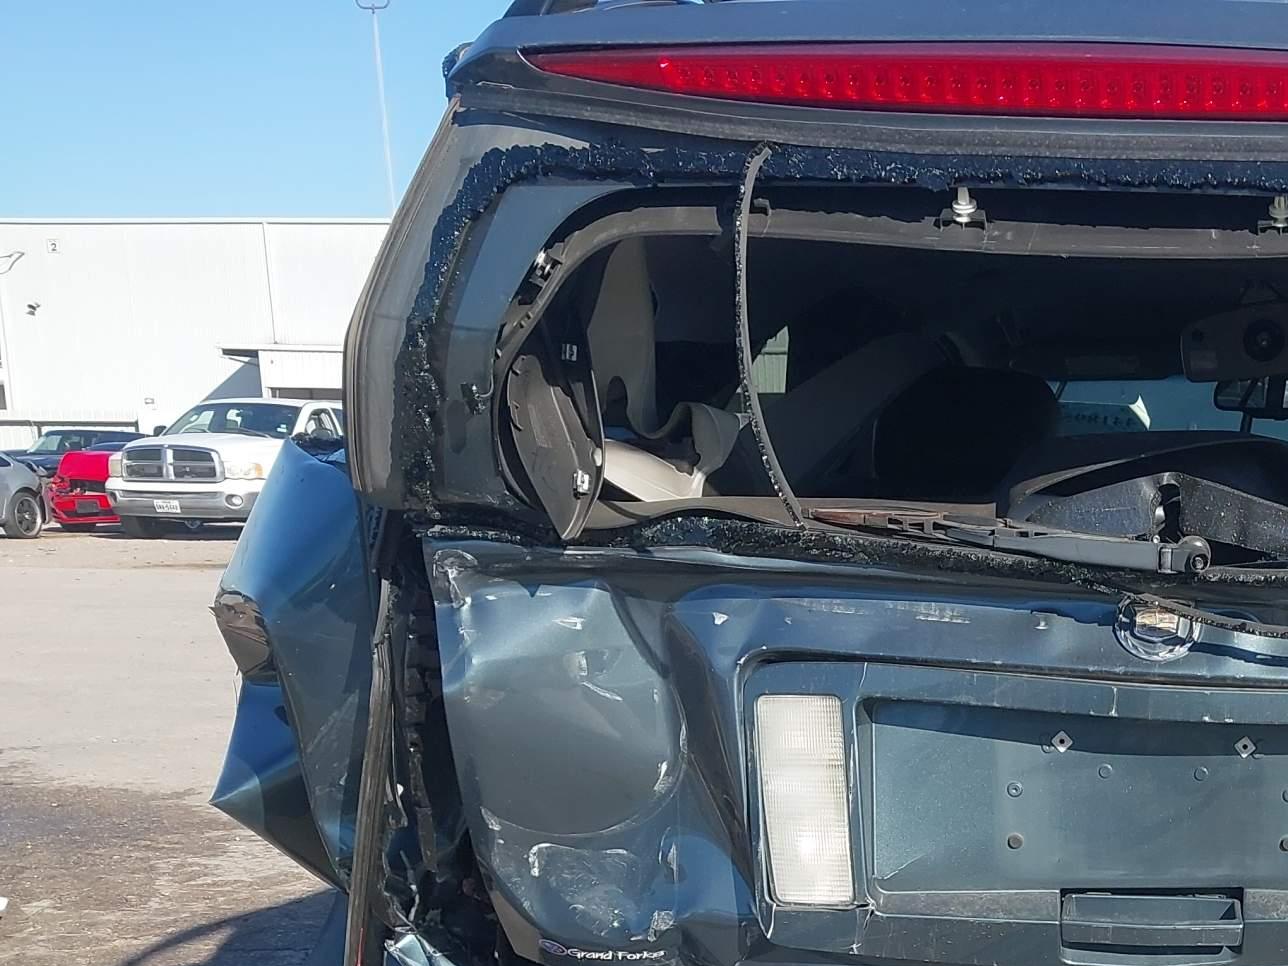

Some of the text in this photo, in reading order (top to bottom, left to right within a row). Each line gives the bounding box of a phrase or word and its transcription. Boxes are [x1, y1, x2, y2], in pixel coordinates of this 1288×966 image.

[50, 242, 58, 252] 2
[567, 948, 666, 961] Grand Forks
